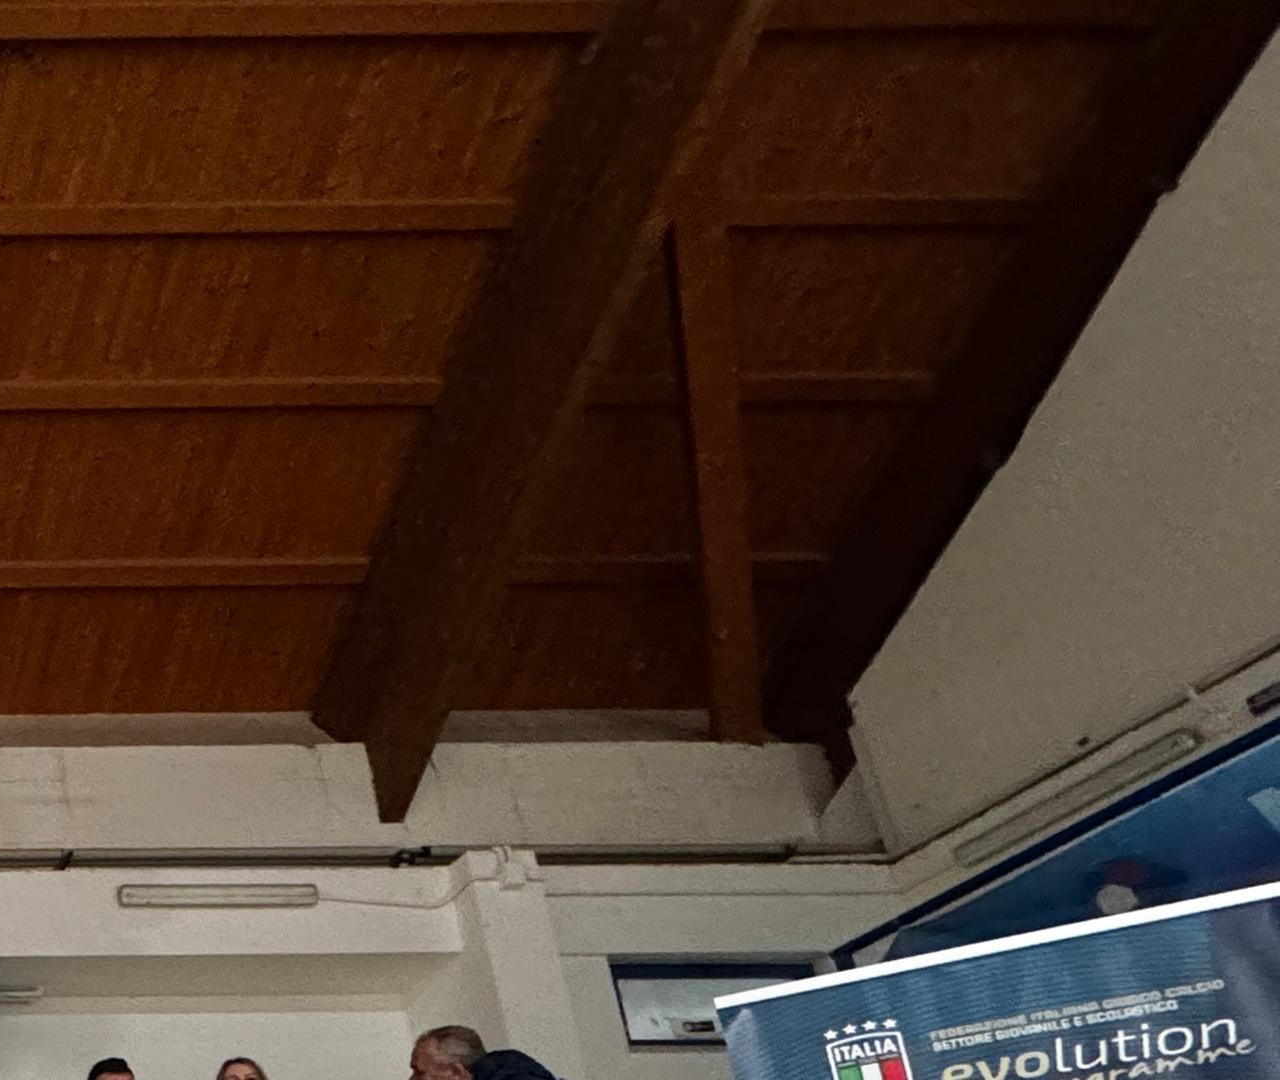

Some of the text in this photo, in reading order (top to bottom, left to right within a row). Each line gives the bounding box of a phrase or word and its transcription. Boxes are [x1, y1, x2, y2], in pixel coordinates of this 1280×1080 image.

[933, 999, 1178, 1052] SETTORE GIOVANILE E SCOLASTICO
[834, 1037, 898, 1063] ITALIA
